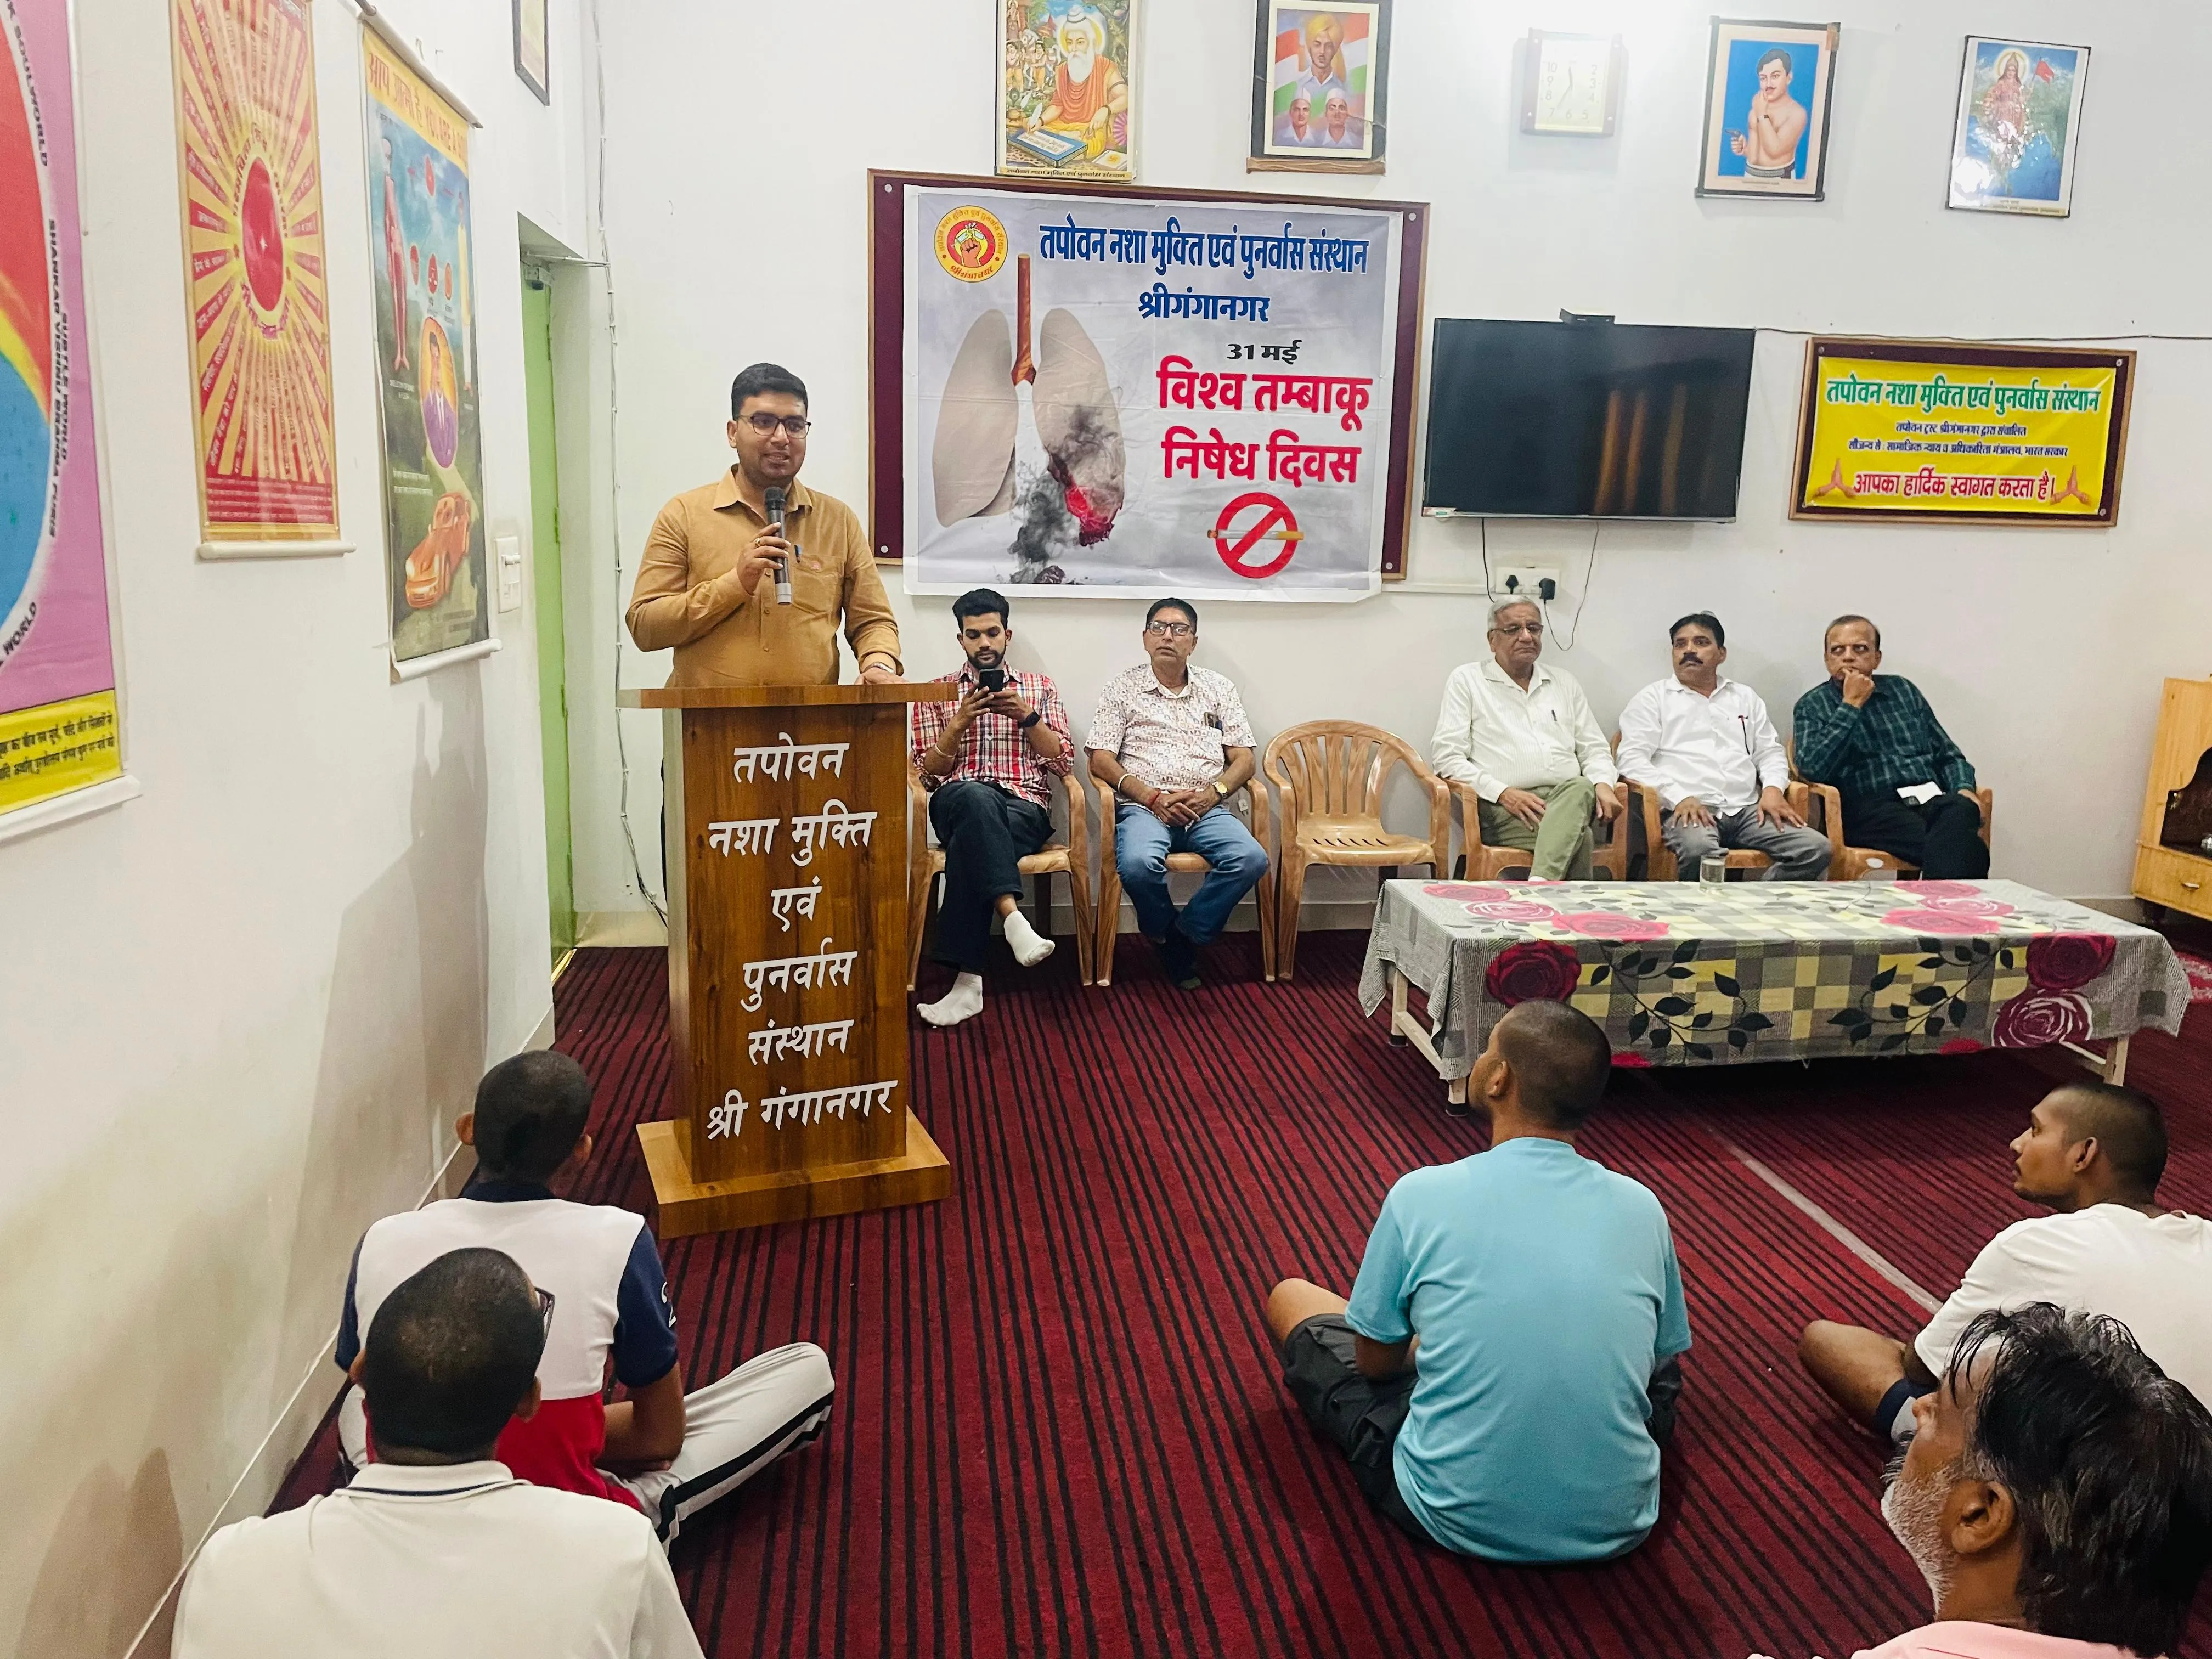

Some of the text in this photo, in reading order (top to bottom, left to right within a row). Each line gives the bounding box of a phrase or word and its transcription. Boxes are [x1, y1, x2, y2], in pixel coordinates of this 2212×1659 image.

[1547, 61, 1558, 72] 10
[1547, 76, 1553, 87] 9
[1591, 64, 1598, 75] 2
[1545, 90, 1552, 100] 8
[1588, 93, 1594, 103] 4
[1590, 78, 1596, 89] 3
[1549, 108, 1555, 117] 7
[1566, 109, 1572, 119] 6
[1582, 110, 1588, 120] 5
[1040, 213, 1369, 280] तपोवन नशा मुक्ति एवं पुनर्वास संस्थान
[1138, 282, 1271, 322] श्रीगंगानगर
[1226, 340, 1302, 365] 31 मई
[1156, 354, 1373, 431] विश्व तम्बाकू
[1826, 373, 2101, 415] तपोवन नशा मुक्ति एवं पुनर्वास संस्थान
[1896, 420, 1922, 432] तपोवन
[1997, 422, 2027, 436] संचालित
[1161, 426, 1362, 488] निषेध दिवस
[1849, 438, 1873, 450] सौजन्य
[1887, 439, 1922, 452] सामाजिक
[2025, 446, 2043, 456] भारत
[2044, 447, 2068, 456] सरकार
[1854, 474, 1900, 494] आपका
[1903, 467, 1948, 496] हार्दिक
[1950, 477, 1996, 497] स्वागत
[1998, 478, 2035, 498] करता
[3, 602, 36, 656] WORLD
[733, 732, 850, 784] तपोवन
[708, 798, 878, 867] नशा मुक्ति
[771, 875, 822, 932] एवं
[740, 937, 858, 1012] पुनर्वास
[748, 1019, 854, 1066] संस्थान
[707, 1080, 898, 1140] श्री गंगानगर
